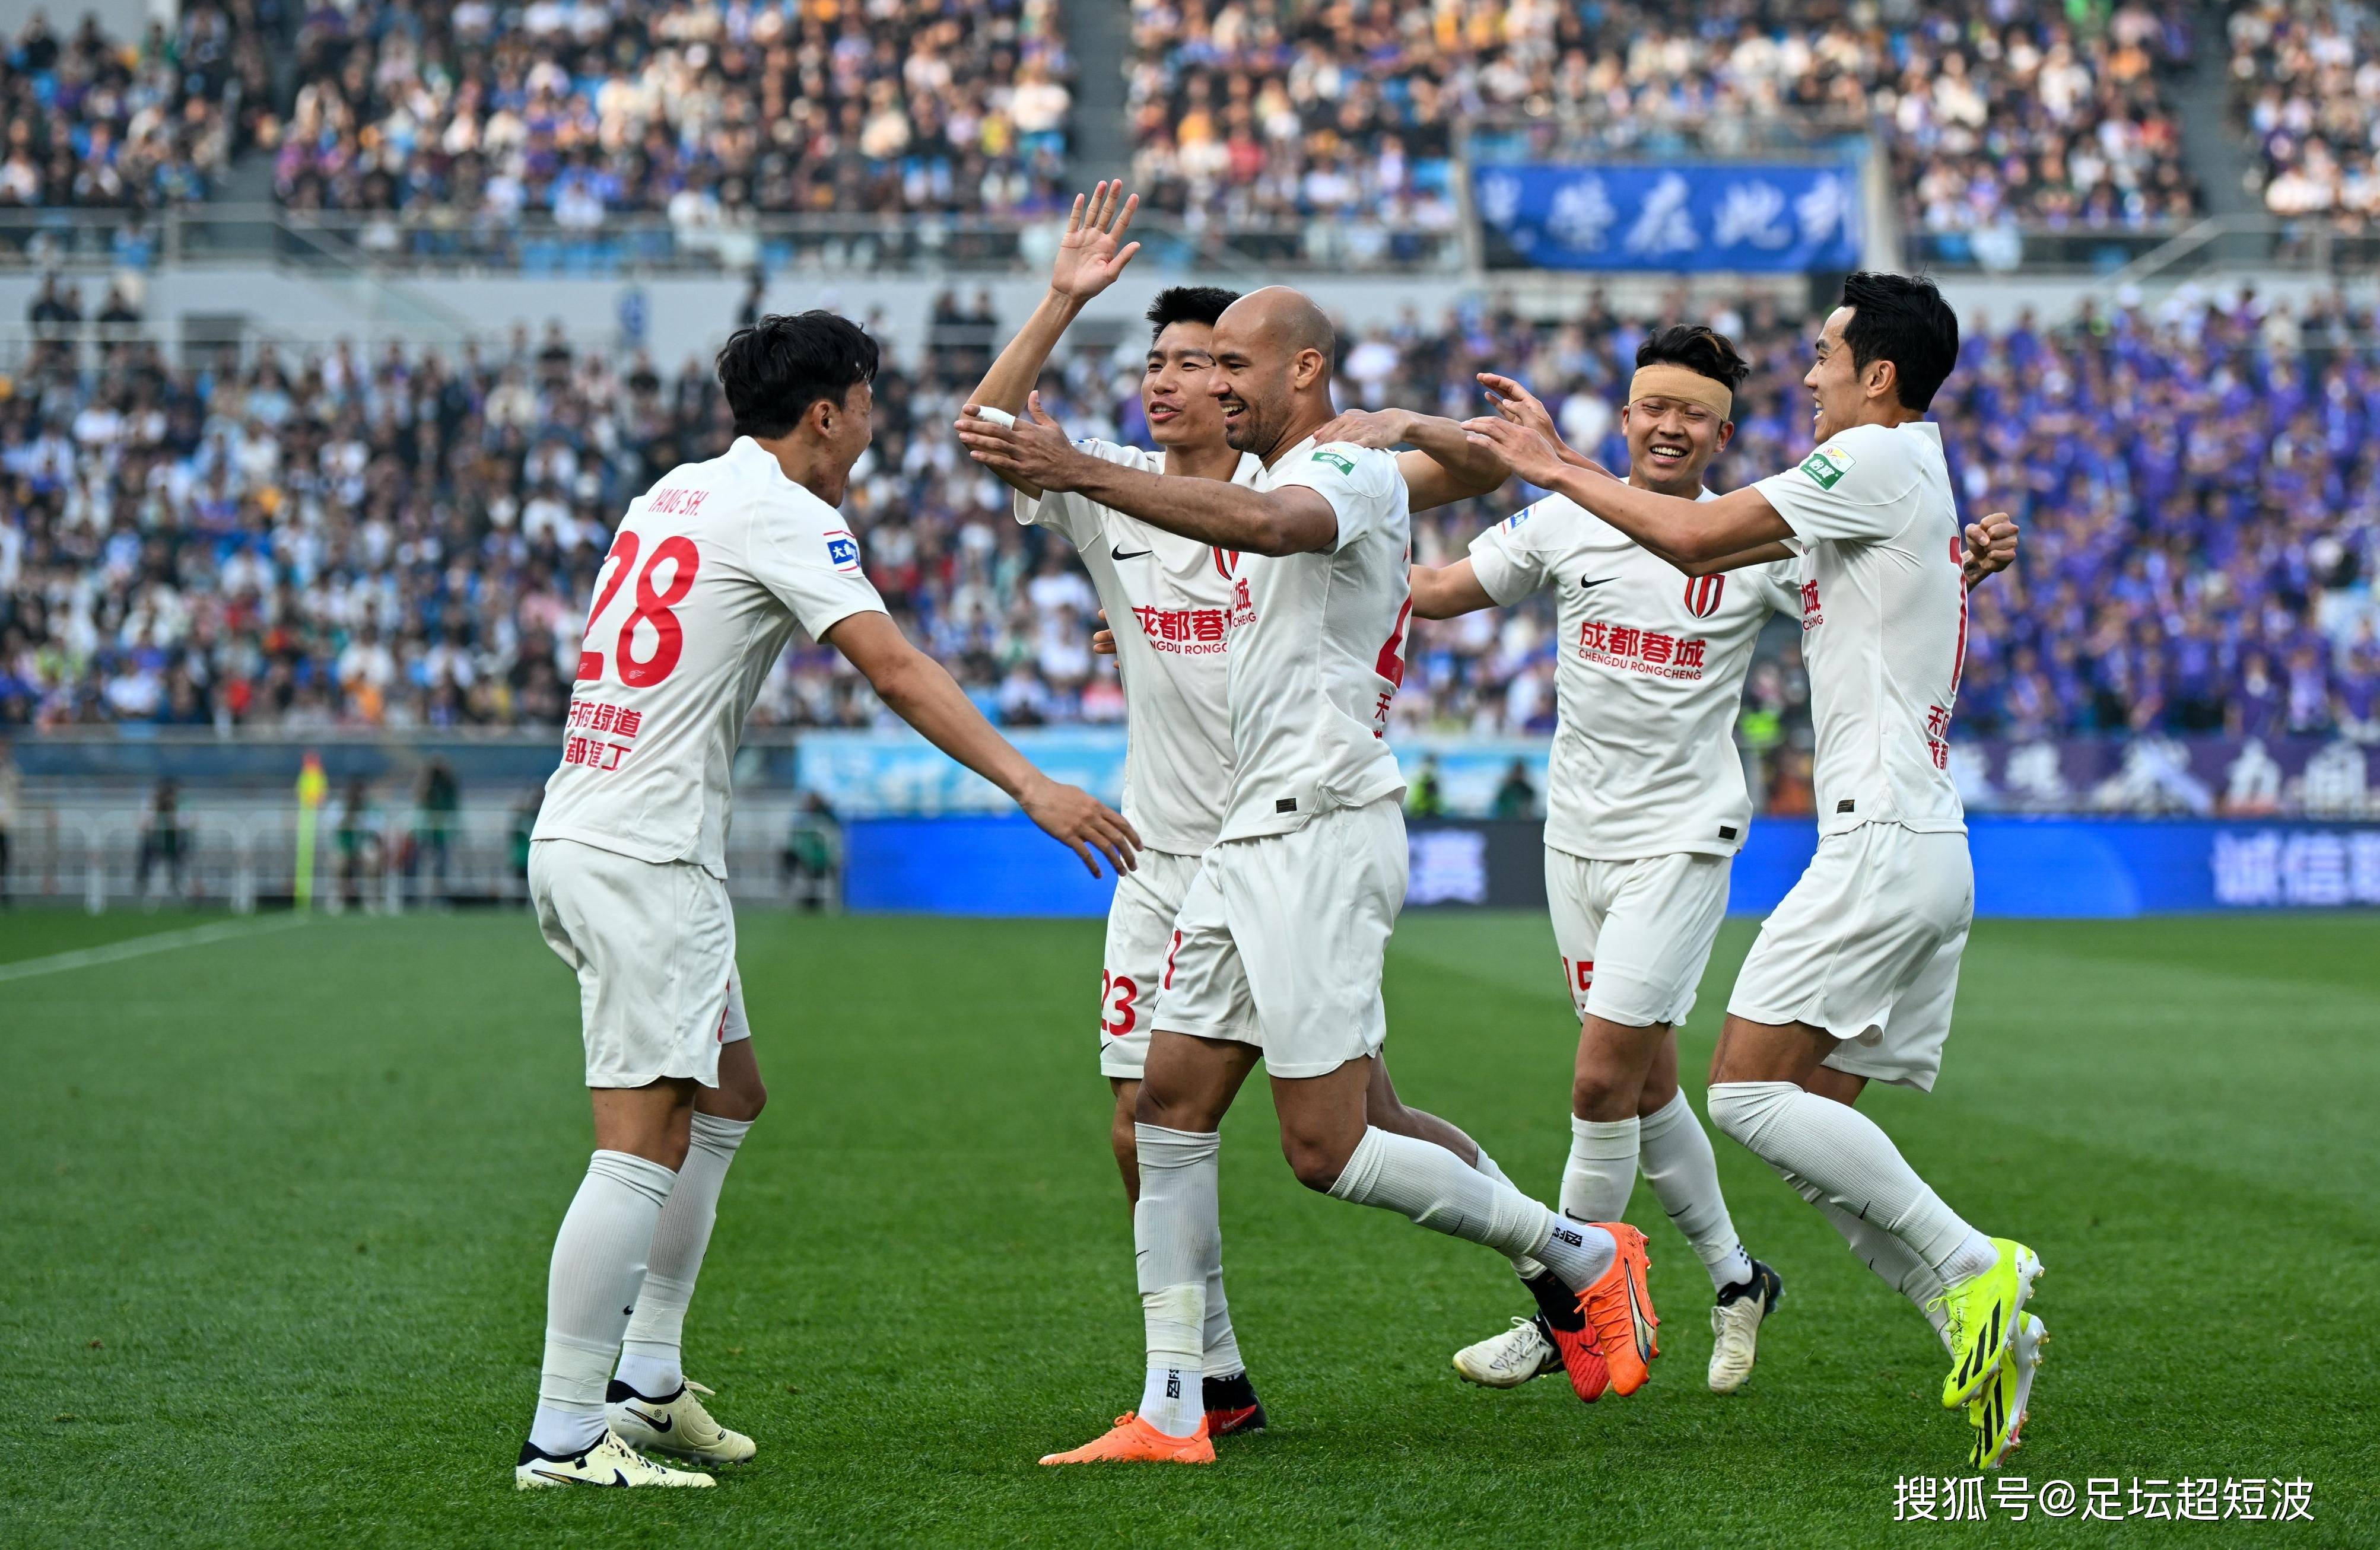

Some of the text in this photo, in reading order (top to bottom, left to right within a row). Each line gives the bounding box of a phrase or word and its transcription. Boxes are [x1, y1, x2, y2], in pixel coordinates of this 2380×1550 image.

[648, 488, 708, 516] YANG SH.
[576, 530, 700, 688] 28
[1230, 578, 1252, 612] 城
[1232, 612, 1257, 628] CHENG
[1149, 640, 1227, 655] NGDU RONGC
[1580, 621, 1707, 669] 成都蓉城
[1578, 649, 1702, 680] CHENGDU RONGCHENG
[1101, 968, 1137, 1036] 23
